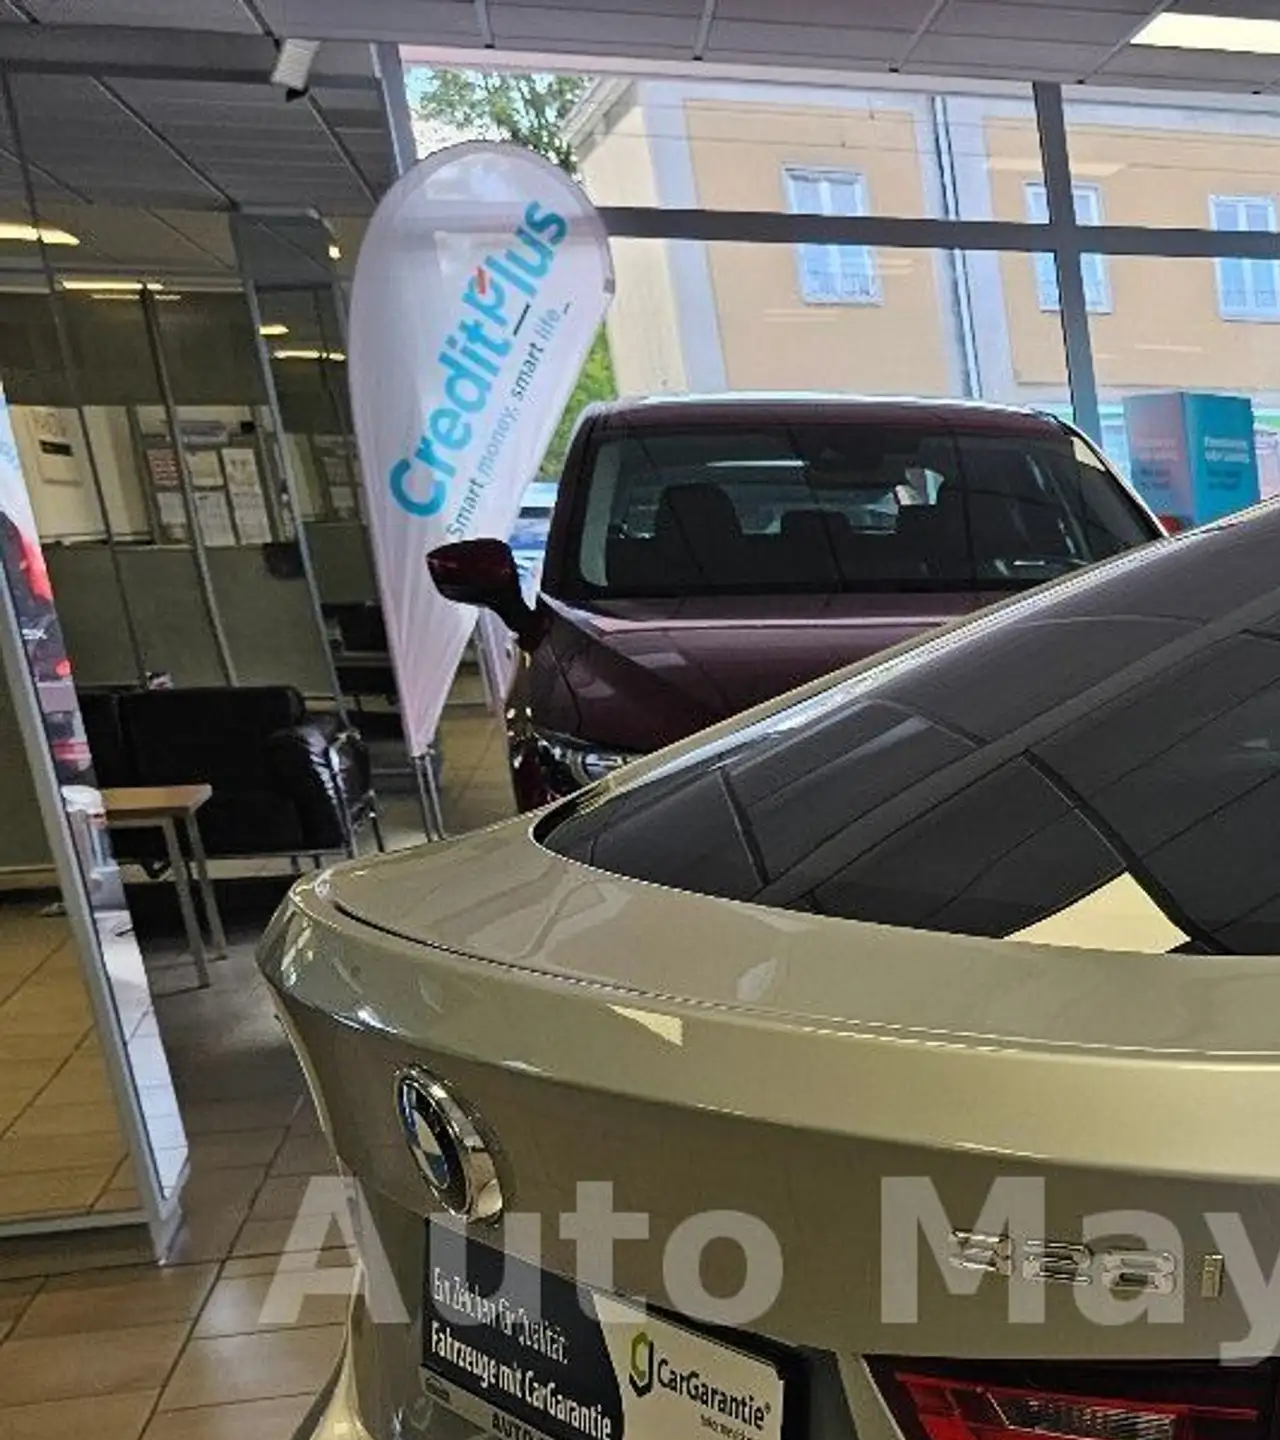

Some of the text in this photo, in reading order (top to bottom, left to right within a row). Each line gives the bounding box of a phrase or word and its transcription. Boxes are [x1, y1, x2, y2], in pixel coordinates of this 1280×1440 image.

[447, 478, 485, 540] Smart
[511, 341, 544, 401] smart
[431, 1320, 496, 1388] Fahrzeuge
[499, 1362, 522, 1398] mit
